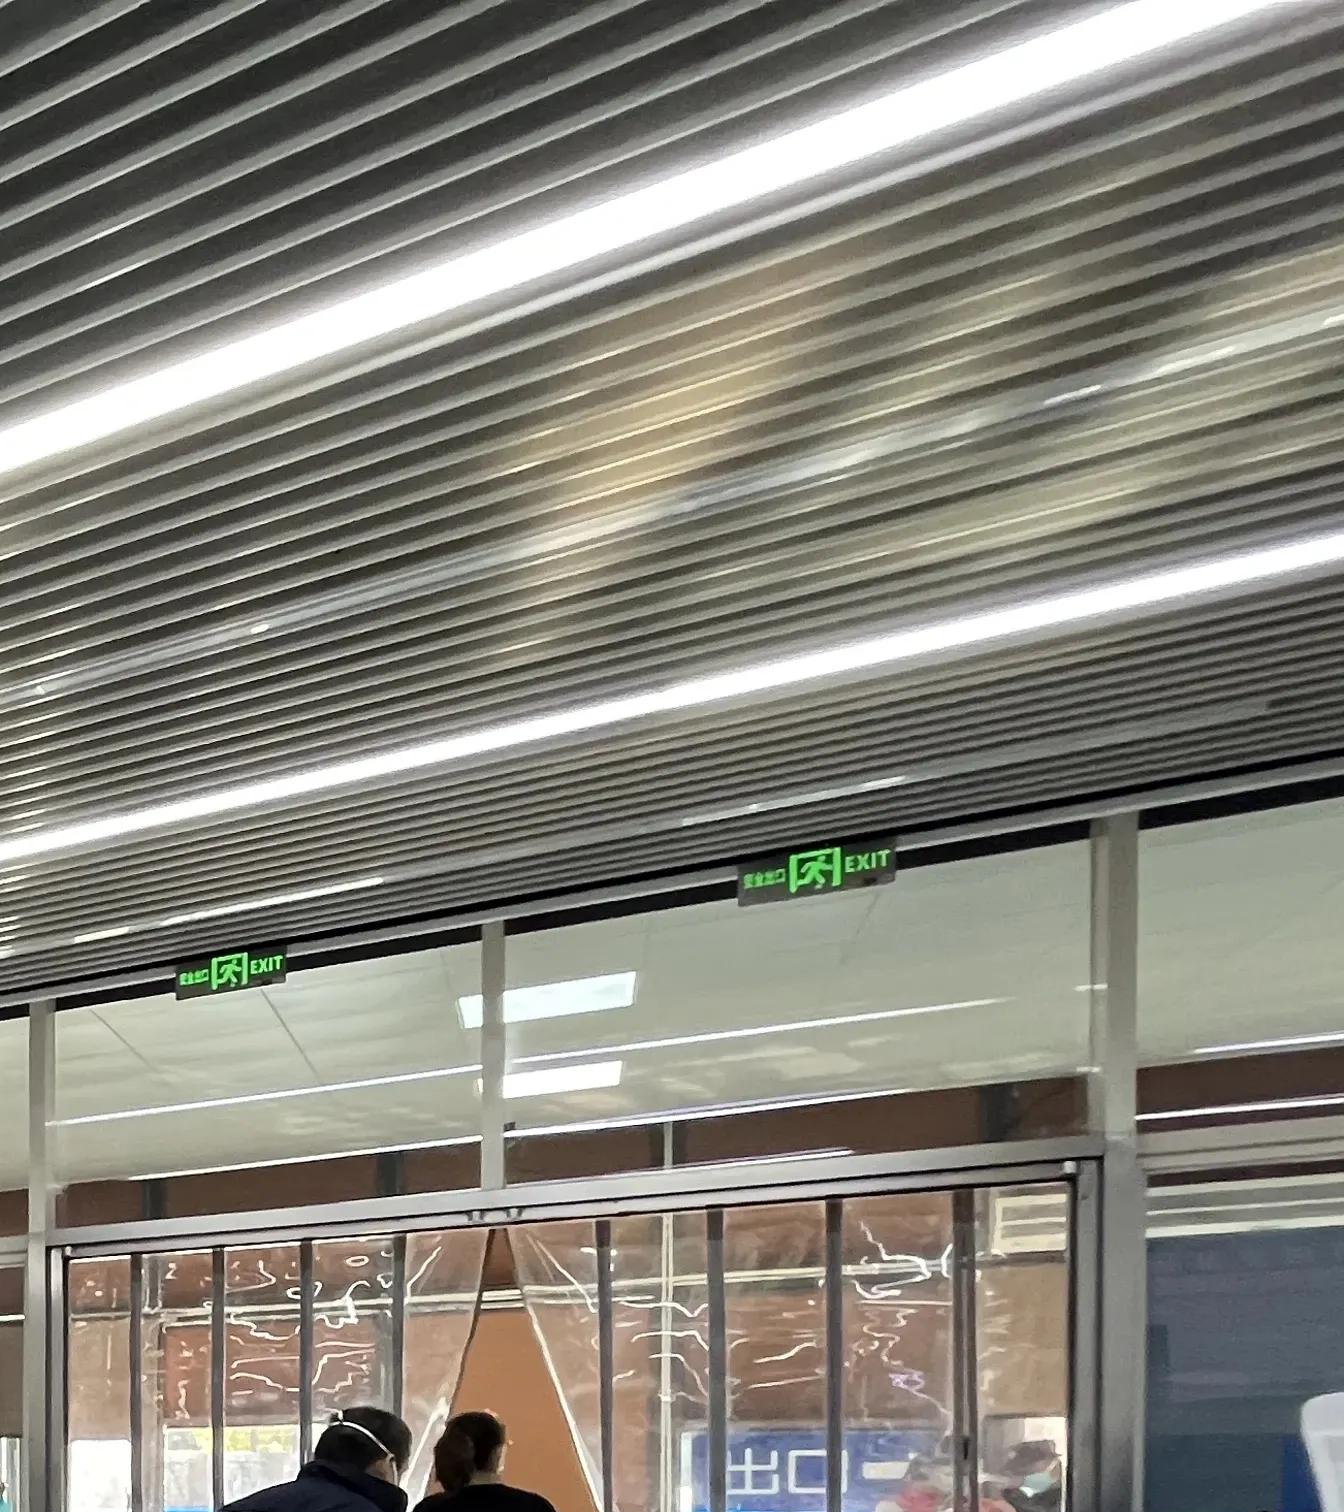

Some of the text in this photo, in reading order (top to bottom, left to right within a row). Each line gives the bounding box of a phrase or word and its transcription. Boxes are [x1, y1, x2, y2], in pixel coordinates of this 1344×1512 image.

[844, 848, 891, 874] EXIT
[250, 954, 284, 975] EXIT
[724, 1447, 849, 1496] 出口
